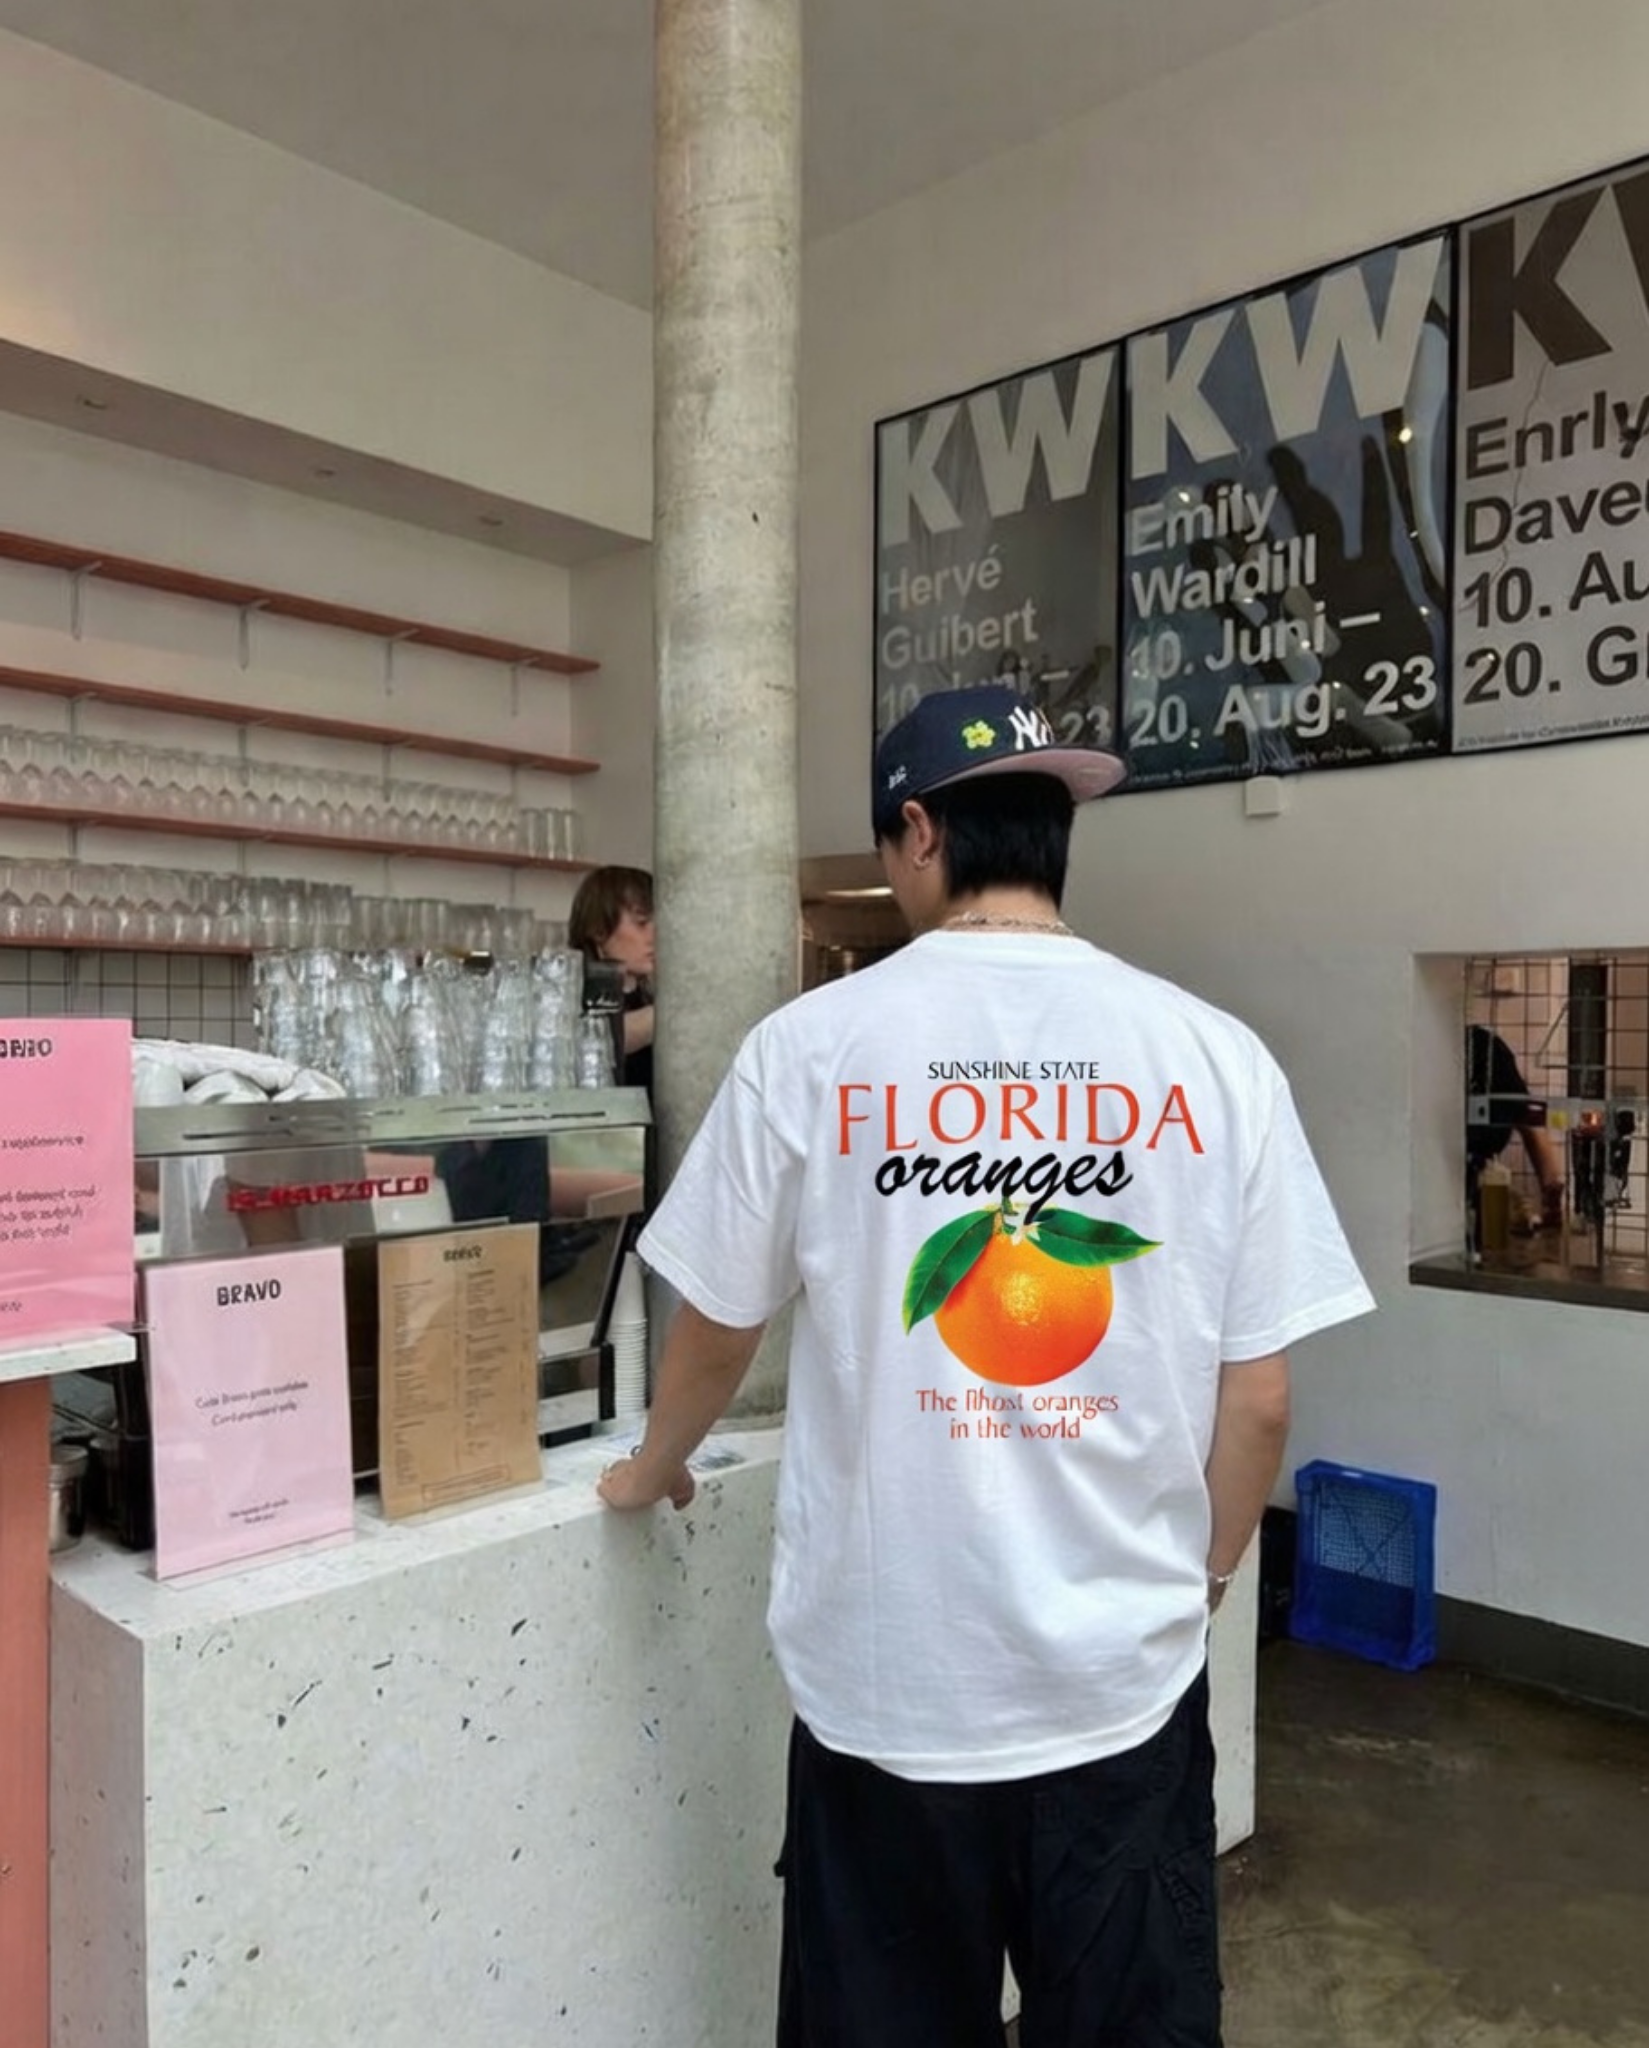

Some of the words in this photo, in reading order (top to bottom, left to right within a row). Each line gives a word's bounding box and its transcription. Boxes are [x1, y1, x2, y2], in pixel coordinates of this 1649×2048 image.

[1130, 236, 1444, 480] KW
[881, 353, 1114, 548] KW
[1130, 483, 1278, 556] Emily
[1465, 477, 1649, 556] Dave
[882, 544, 1001, 614] Hervé
[1131, 533, 1316, 618] Wardill
[1464, 566, 1552, 628] 10.
[882, 598, 1039, 670] Guibert
[1204, 600, 1326, 671] Juni
[1463, 641, 1561, 704] 20.
[1586, 626, 1649, 686] G
[1129, 694, 1200, 750] 20.
[1213, 683, 1347, 738] Aug.
[1363, 655, 1438, 717] 23
[928, 1061, 1032, 1079] SUNSHINE
[1040, 1062, 1100, 1079] STATE
[838, 1083, 1205, 1155] FLORIDA
[875, 1150, 1133, 1226] oranges
[217, 1279, 281, 1306] BRAVO
[915, 1388, 957, 1412] The
[1032, 1394, 1119, 1420] oranges
[950, 1418, 969, 1439] in
[1020, 1416, 1081, 1439] world
